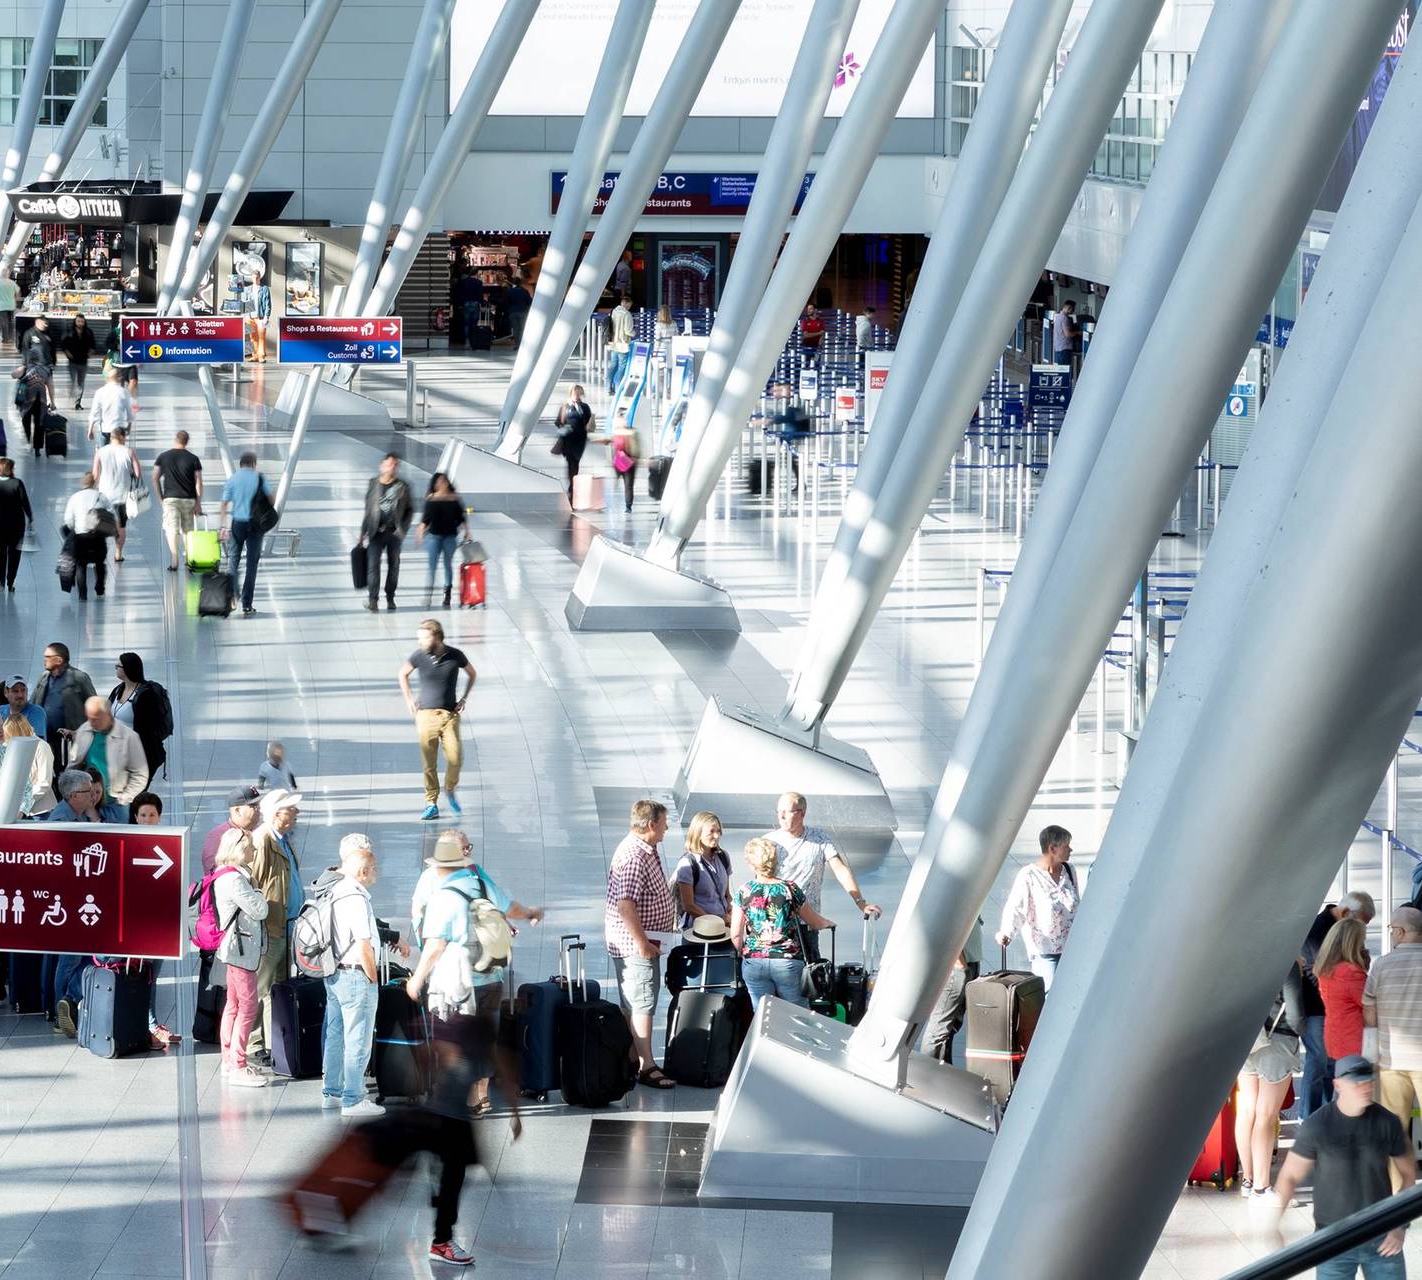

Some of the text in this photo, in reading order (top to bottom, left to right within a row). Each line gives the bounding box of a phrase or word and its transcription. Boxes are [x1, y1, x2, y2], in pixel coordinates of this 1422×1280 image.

[18, 198, 122, 217] Caffè RITAZZA
[286, 325, 309, 333] Shops
[165, 346, 213, 355] Information
[327, 351, 358, 359] Customs
[33, 889, 50, 899] WC
